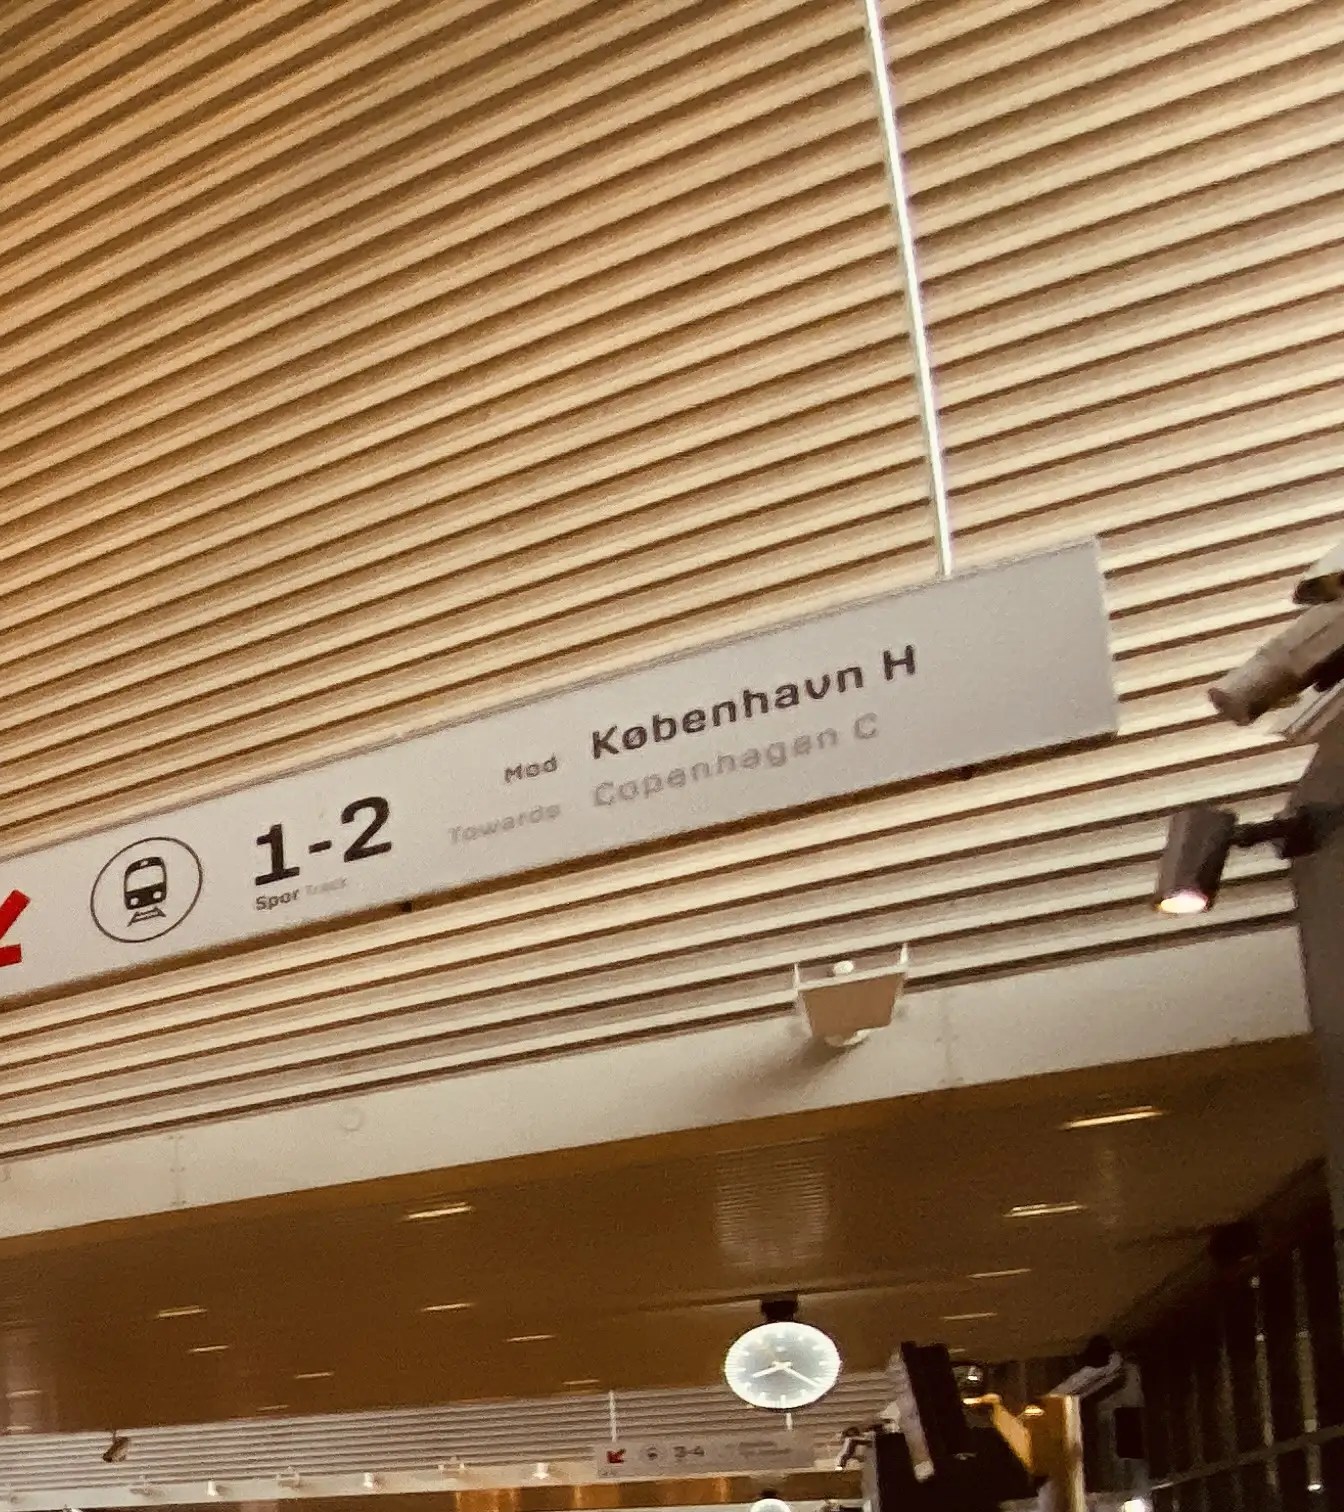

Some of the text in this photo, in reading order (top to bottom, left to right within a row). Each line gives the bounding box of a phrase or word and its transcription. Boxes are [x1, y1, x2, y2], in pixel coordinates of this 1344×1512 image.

[504, 645, 916, 784] Mod København H
[448, 712, 879, 845] Towards Copenhagen C
[255, 797, 392, 886] 1-2
[255, 878, 346, 911] Spor Trk
